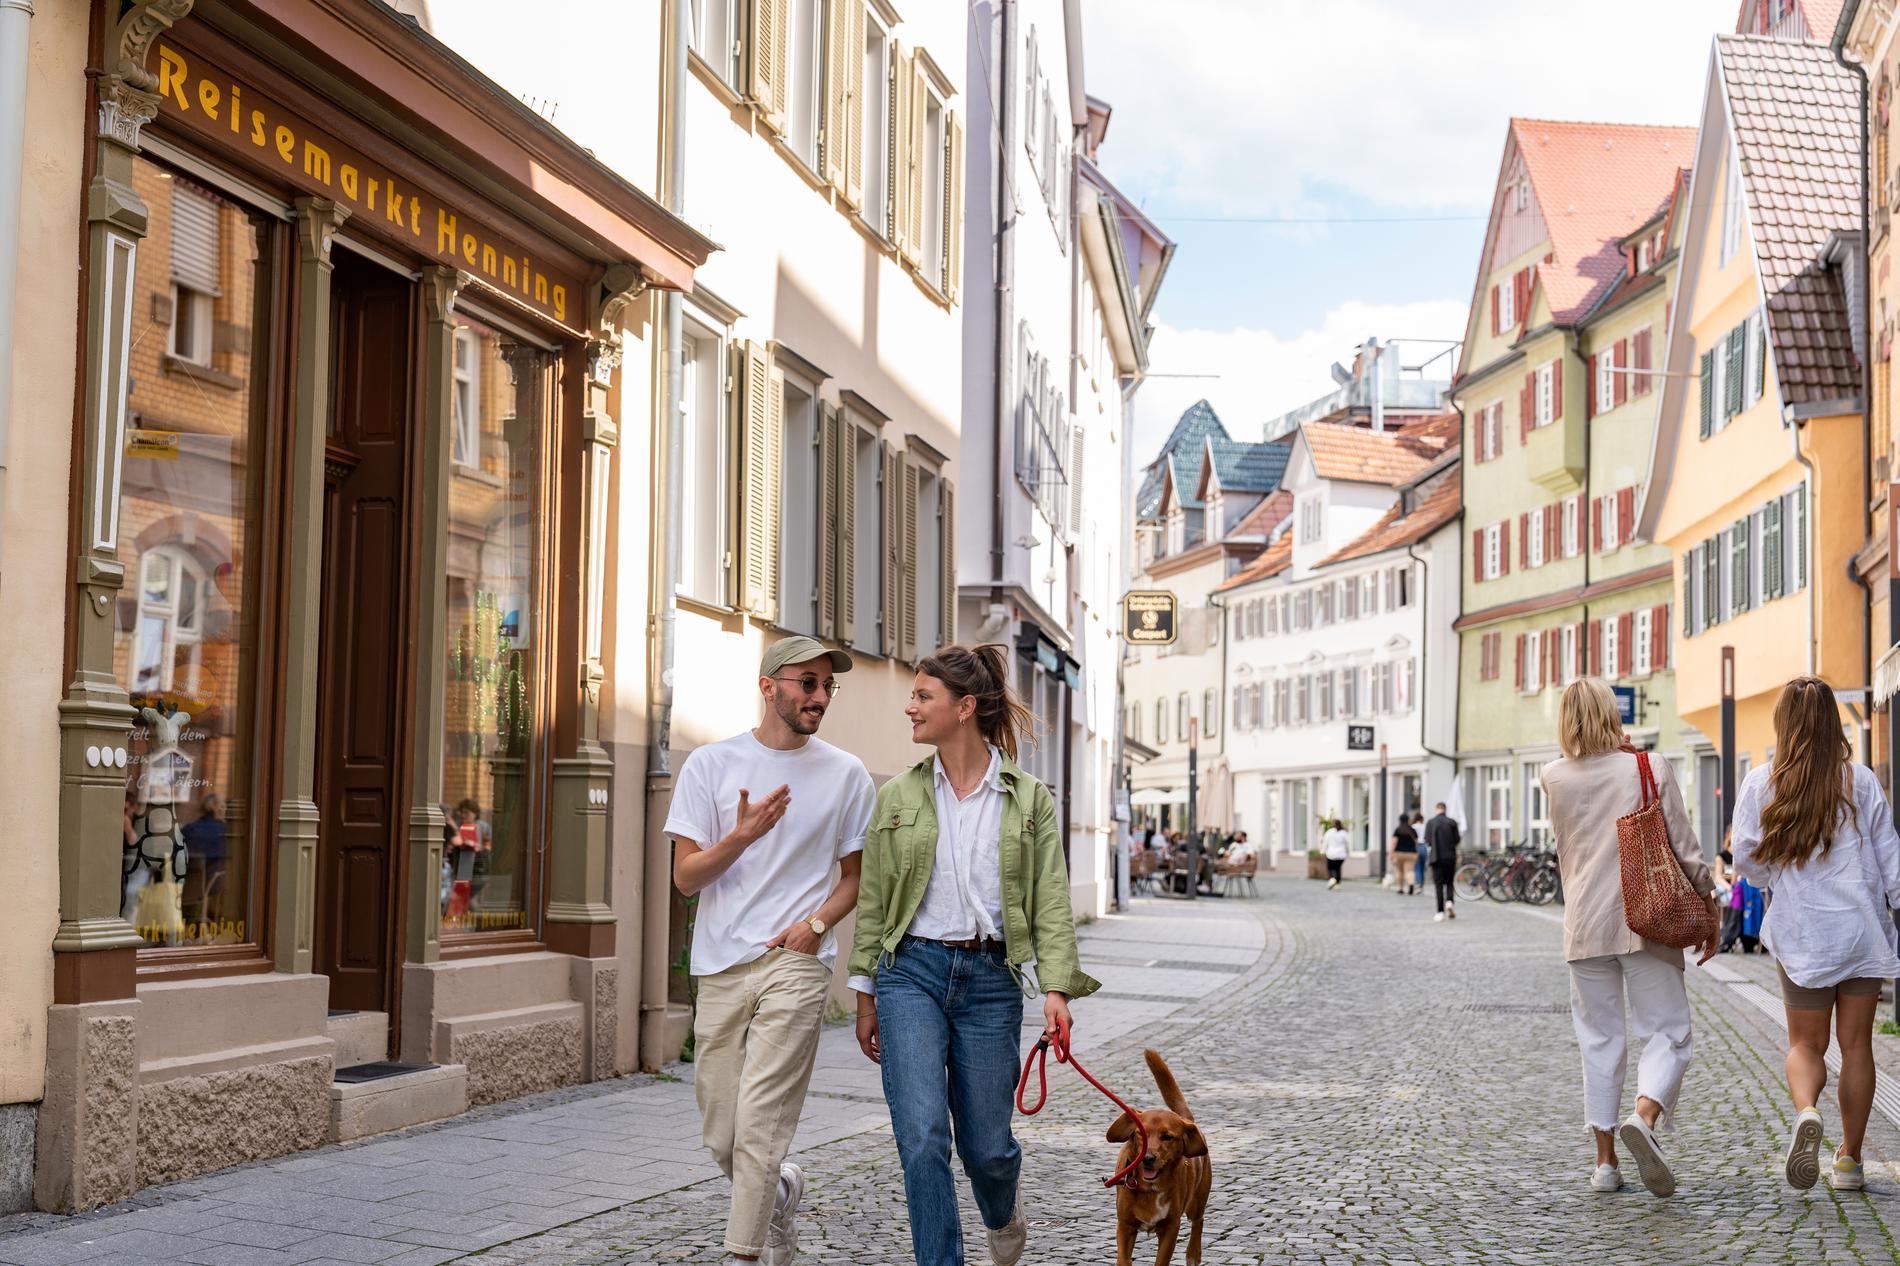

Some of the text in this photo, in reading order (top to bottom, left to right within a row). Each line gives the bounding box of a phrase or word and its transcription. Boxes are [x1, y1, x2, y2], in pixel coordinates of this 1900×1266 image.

[160, 44, 565, 321] Reisemarkt Henning
[180, 727, 206, 741] dem
